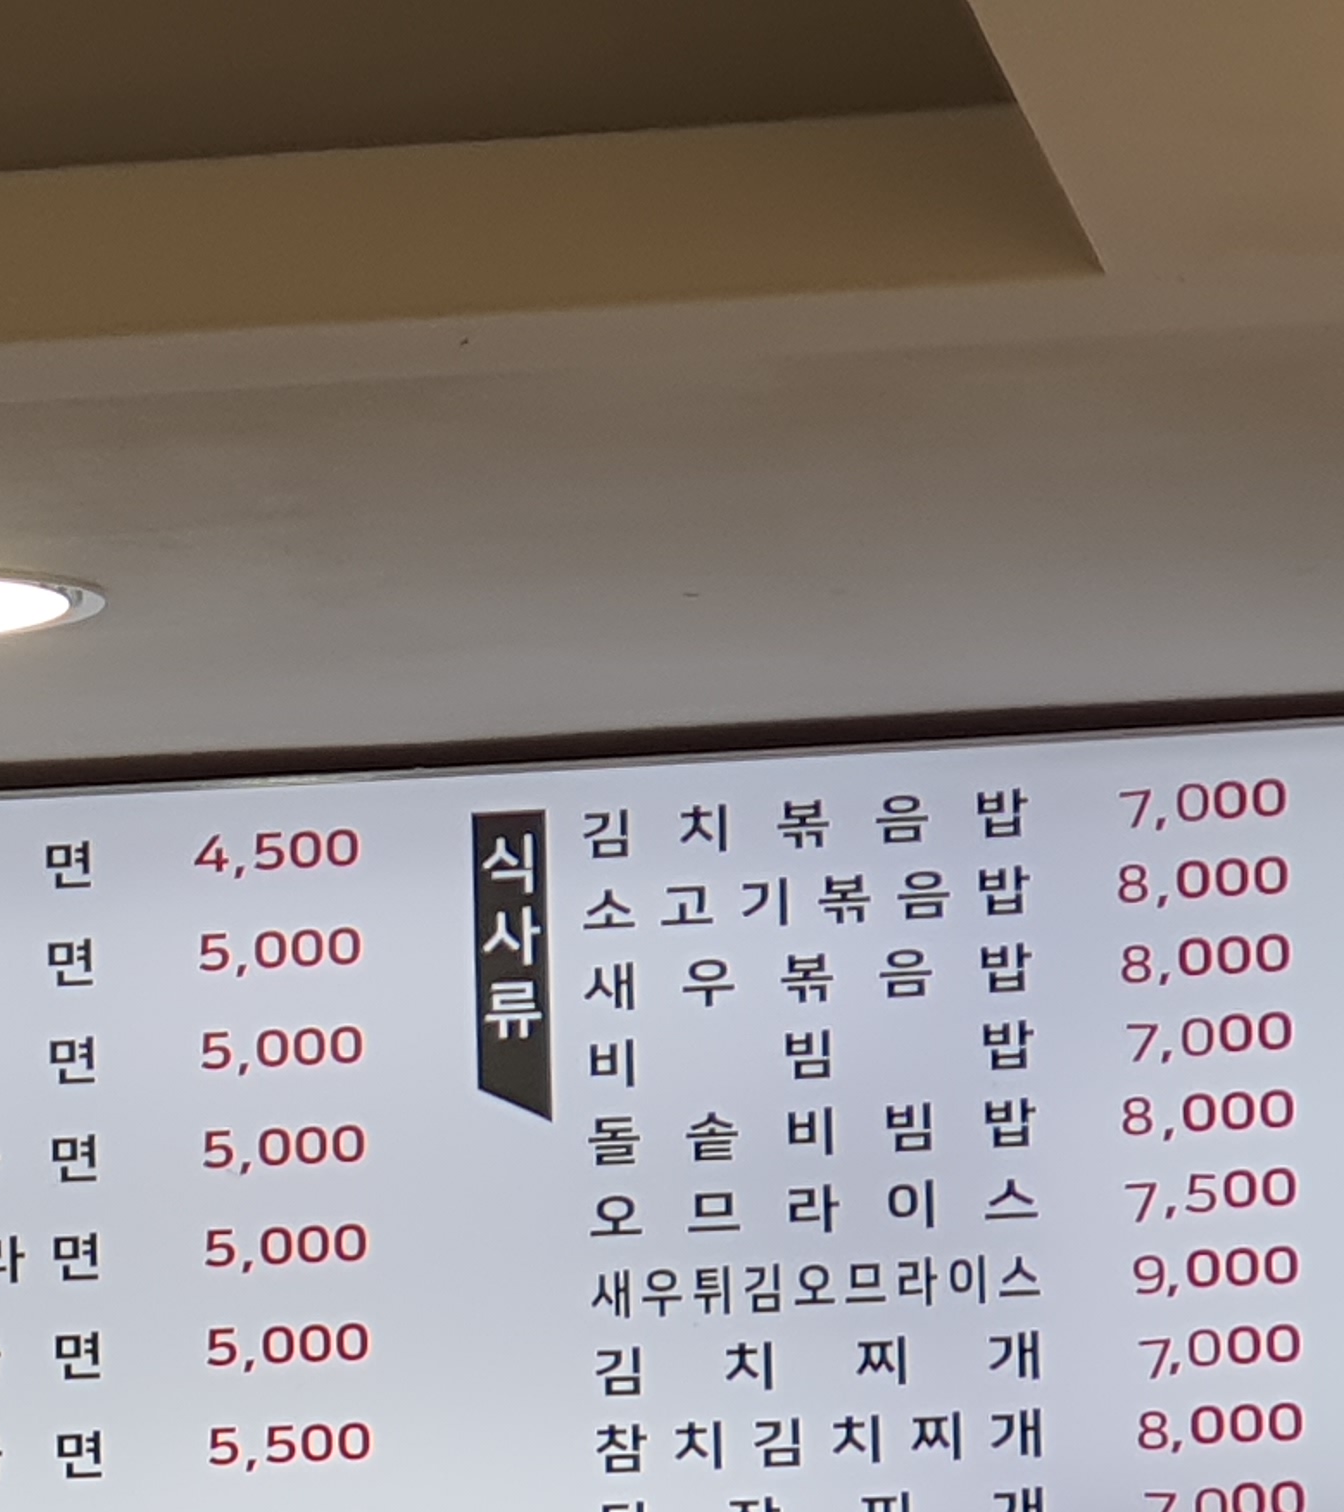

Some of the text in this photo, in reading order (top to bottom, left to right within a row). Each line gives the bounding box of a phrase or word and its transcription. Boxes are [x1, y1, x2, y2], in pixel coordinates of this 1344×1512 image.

[1120, 779, 1285, 830] 7,000
[194, 829, 358, 879] 4,500
[1118, 856, 1287, 908] 8,000
[200, 927, 360, 977] 5,000
[481, 833, 543, 1040] 식사류
[1121, 934, 1289, 985] 8,000
[202, 1026, 362, 1076] 5,000
[1127, 1012, 1292, 1063] 7,000
[1123, 1090, 1294, 1141] 8,000
[203, 1125, 364, 1175] 5,000
[1125, 1168, 1296, 1222] 7,500
[205, 1224, 366, 1273] 5,000
[592, 1246, 1298, 1319] 새우튀김오므라이스 9,000
[207, 1323, 368, 1372] 5,000
[1139, 1324, 1300, 1379] 7,000
[209, 1422, 370, 1472] 5,500
[1138, 1403, 1302, 1453] 8,000
